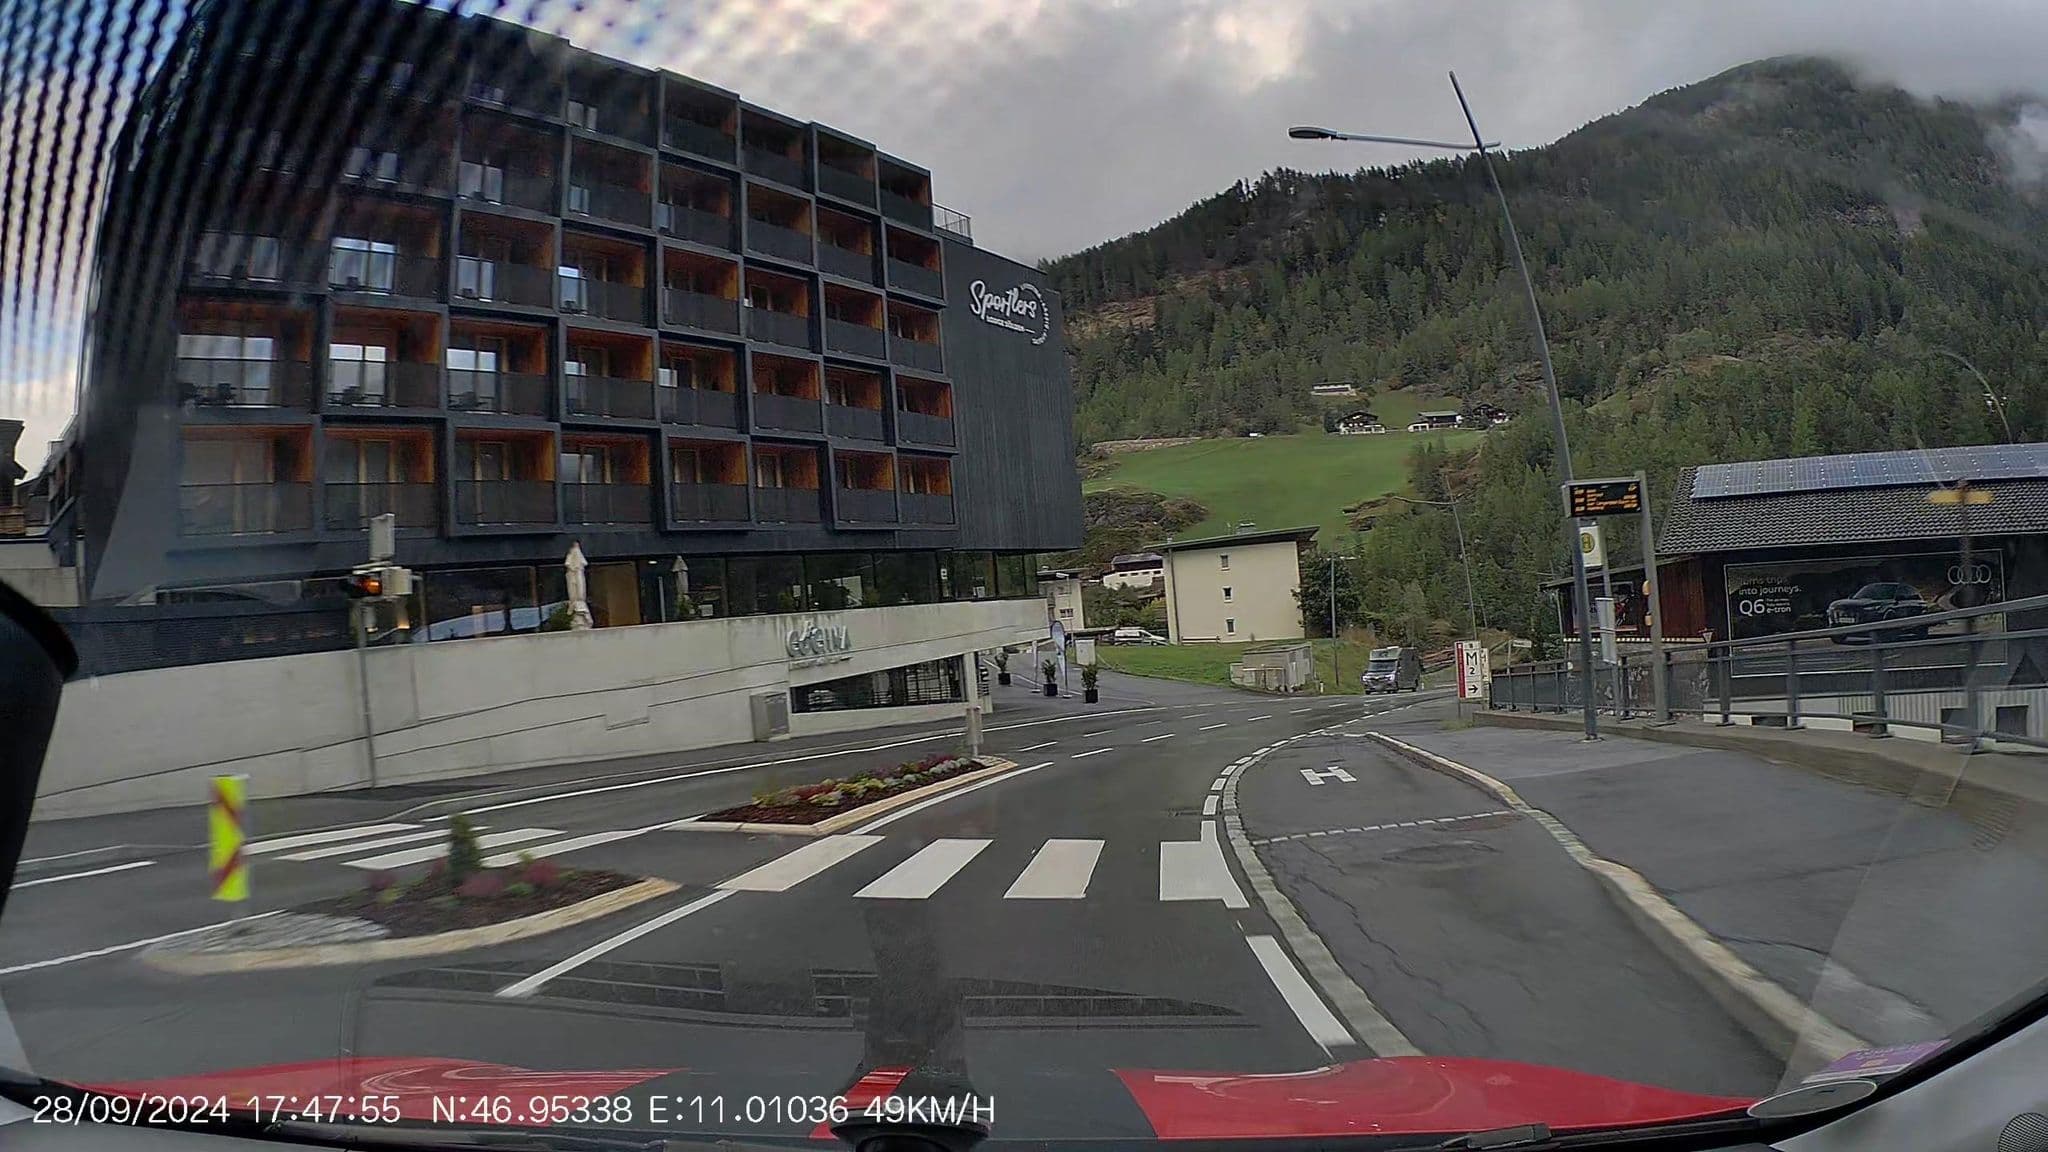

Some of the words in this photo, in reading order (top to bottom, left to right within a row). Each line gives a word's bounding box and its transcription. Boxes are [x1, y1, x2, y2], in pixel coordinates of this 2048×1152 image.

[969, 279, 1037, 320] Sportlers
[1739, 587, 1758, 596] into
[1759, 585, 1802, 596] journeys.
[1739, 599, 1766, 617] Q6
[1766, 606, 1792, 614] e-tron
[1466, 652, 1478, 666] M
[1469, 666, 1476, 675] 2
